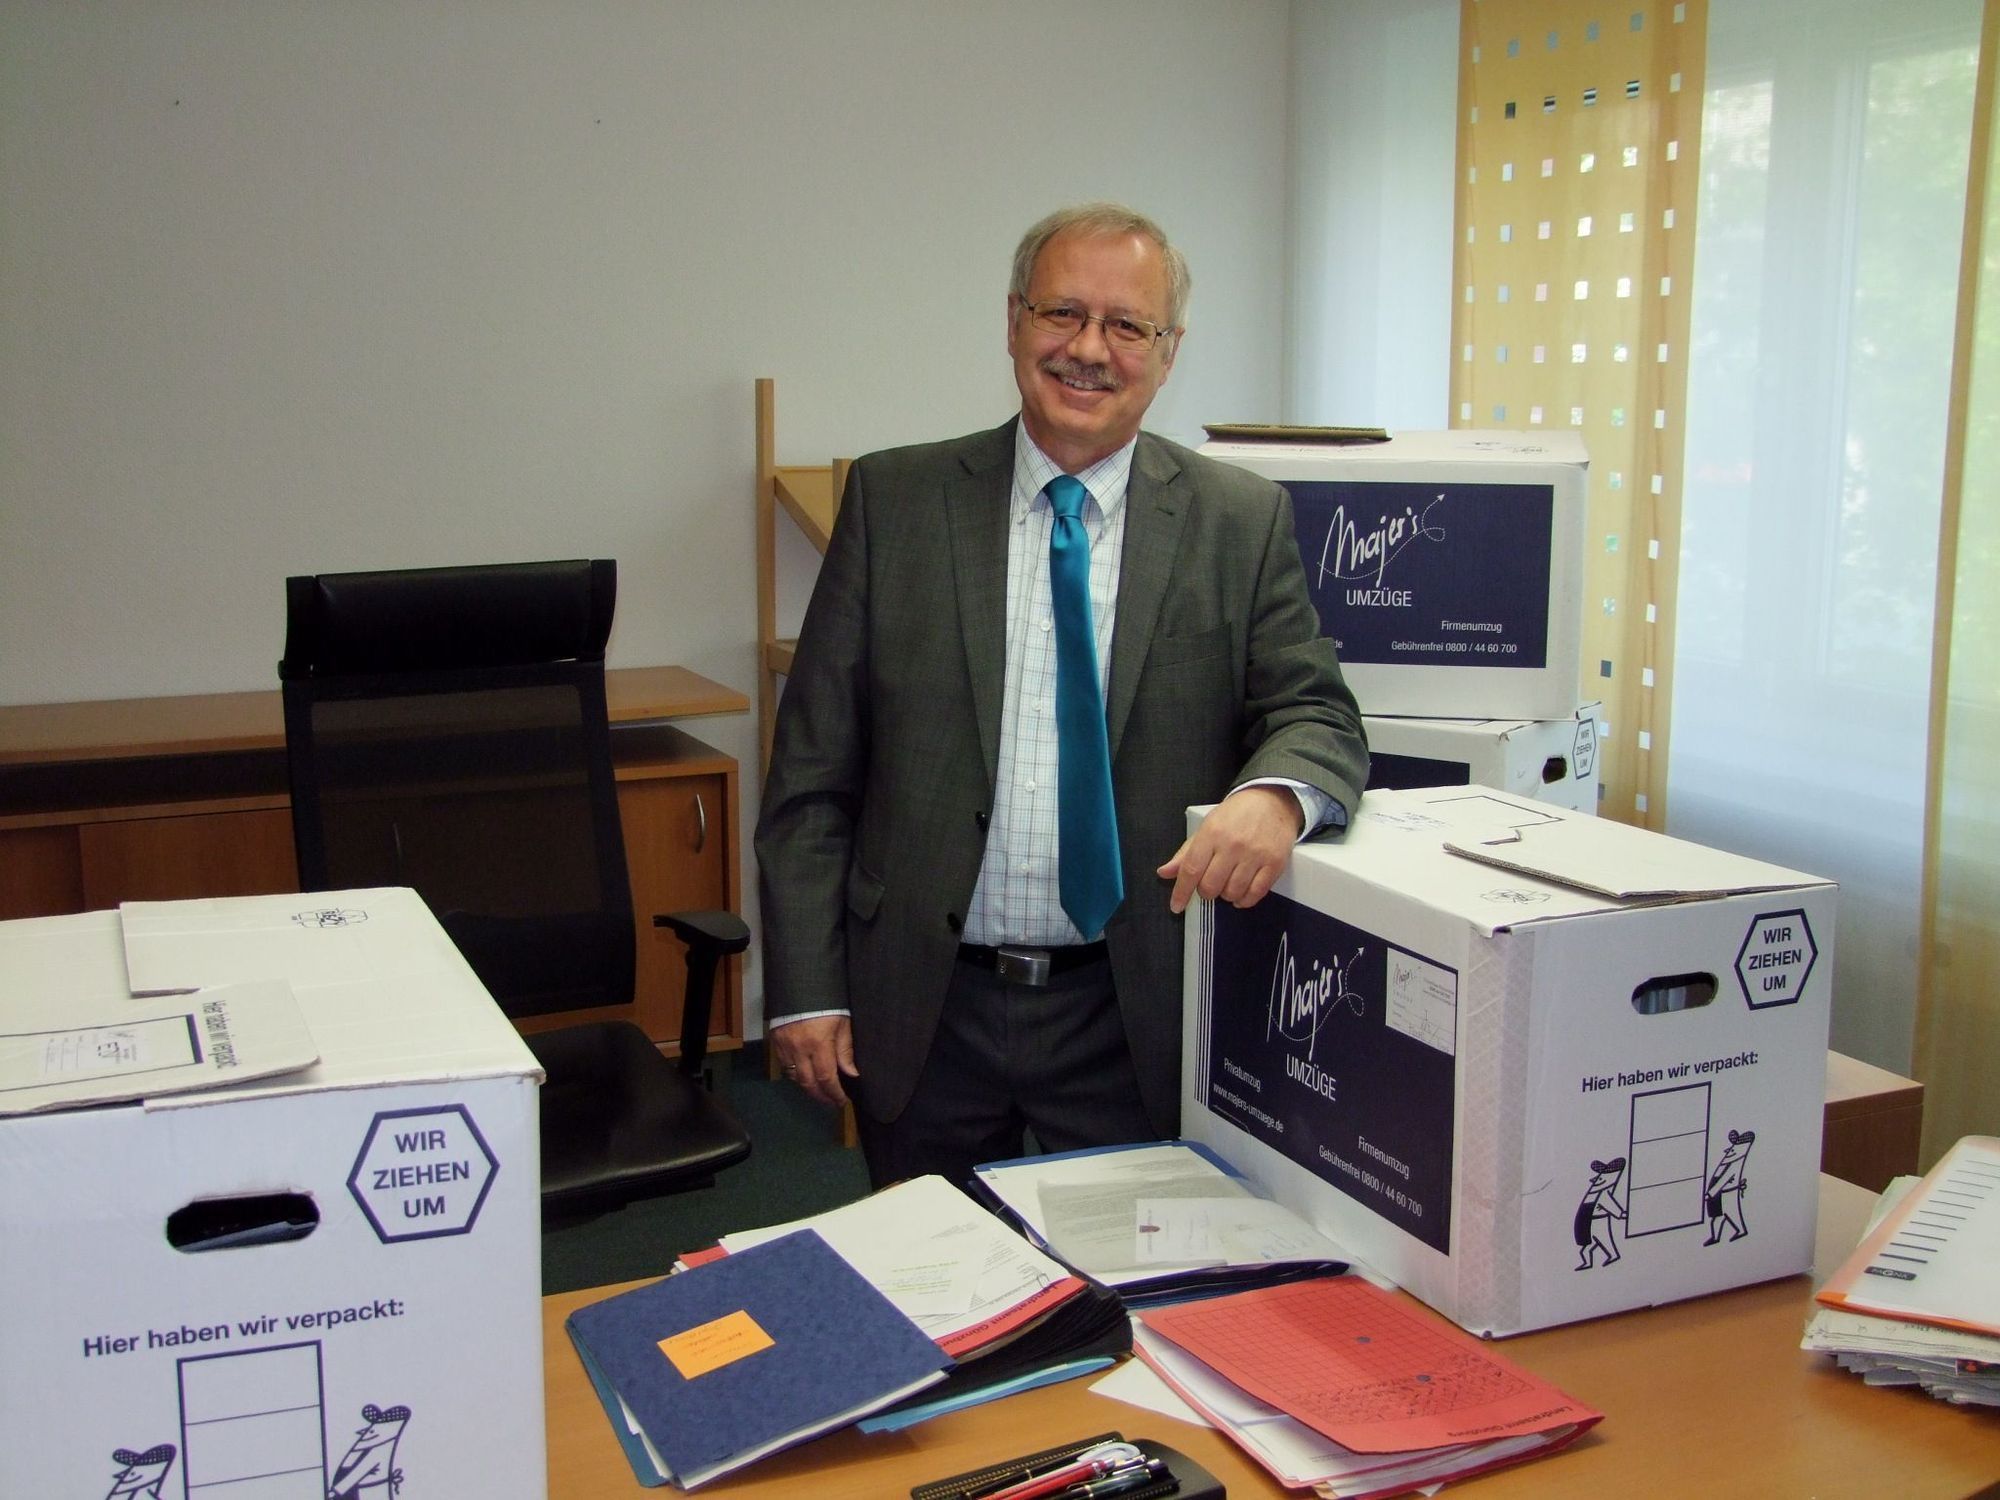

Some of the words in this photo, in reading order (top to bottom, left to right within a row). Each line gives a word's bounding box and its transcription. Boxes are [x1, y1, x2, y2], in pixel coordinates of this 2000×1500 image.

[1346, 587, 1412, 607] UMZÜGE
[1441, 620, 1503, 634] Firmenumzug
[1391, 641, 1444, 652] Gebührenfrei
[1445, 642, 1467, 653] 0800
[1474, 643, 1486, 652] 44
[1487, 643, 1499, 653] 60
[1501, 643, 1518, 653] 700
[1763, 927, 1792, 944] WIR
[1748, 949, 1802, 970] ZIEHEN
[1763, 975, 1786, 991] UM
[1224, 1057, 1261, 1093] Privatumzug
[1286, 1053, 1337, 1102] UMZÜGE
[1582, 1076, 1614, 1093] Hier
[1618, 1069, 1663, 1087] haben
[1668, 1062, 1690, 1079] wir
[1694, 1051, 1759, 1074] verpackt:
[1213, 1083, 1284, 1133] www.majers-umzuege.de
[394, 1130, 446, 1154] WIR
[1358, 1135, 1410, 1180] Firmenumzug
[373, 1161, 470, 1191] ZIEHEN
[1318, 1145, 1361, 1180] Gebührenfrei
[1361, 1171, 1380, 1191] 0800
[1385, 1185, 1396, 1201] 44
[1396, 1191, 1407, 1208] 60
[1407, 1197, 1423, 1217] 700
[403, 1195, 446, 1219] UM
[990, 1283, 1058, 1325] Landratsamt
[83, 1334, 140, 1358] Hier
[148, 1324, 230, 1350] haben
[238, 1315, 279, 1337] wir
[286, 1299, 405, 1331] verpackt:
[943, 1325, 989, 1347] Günzbur
